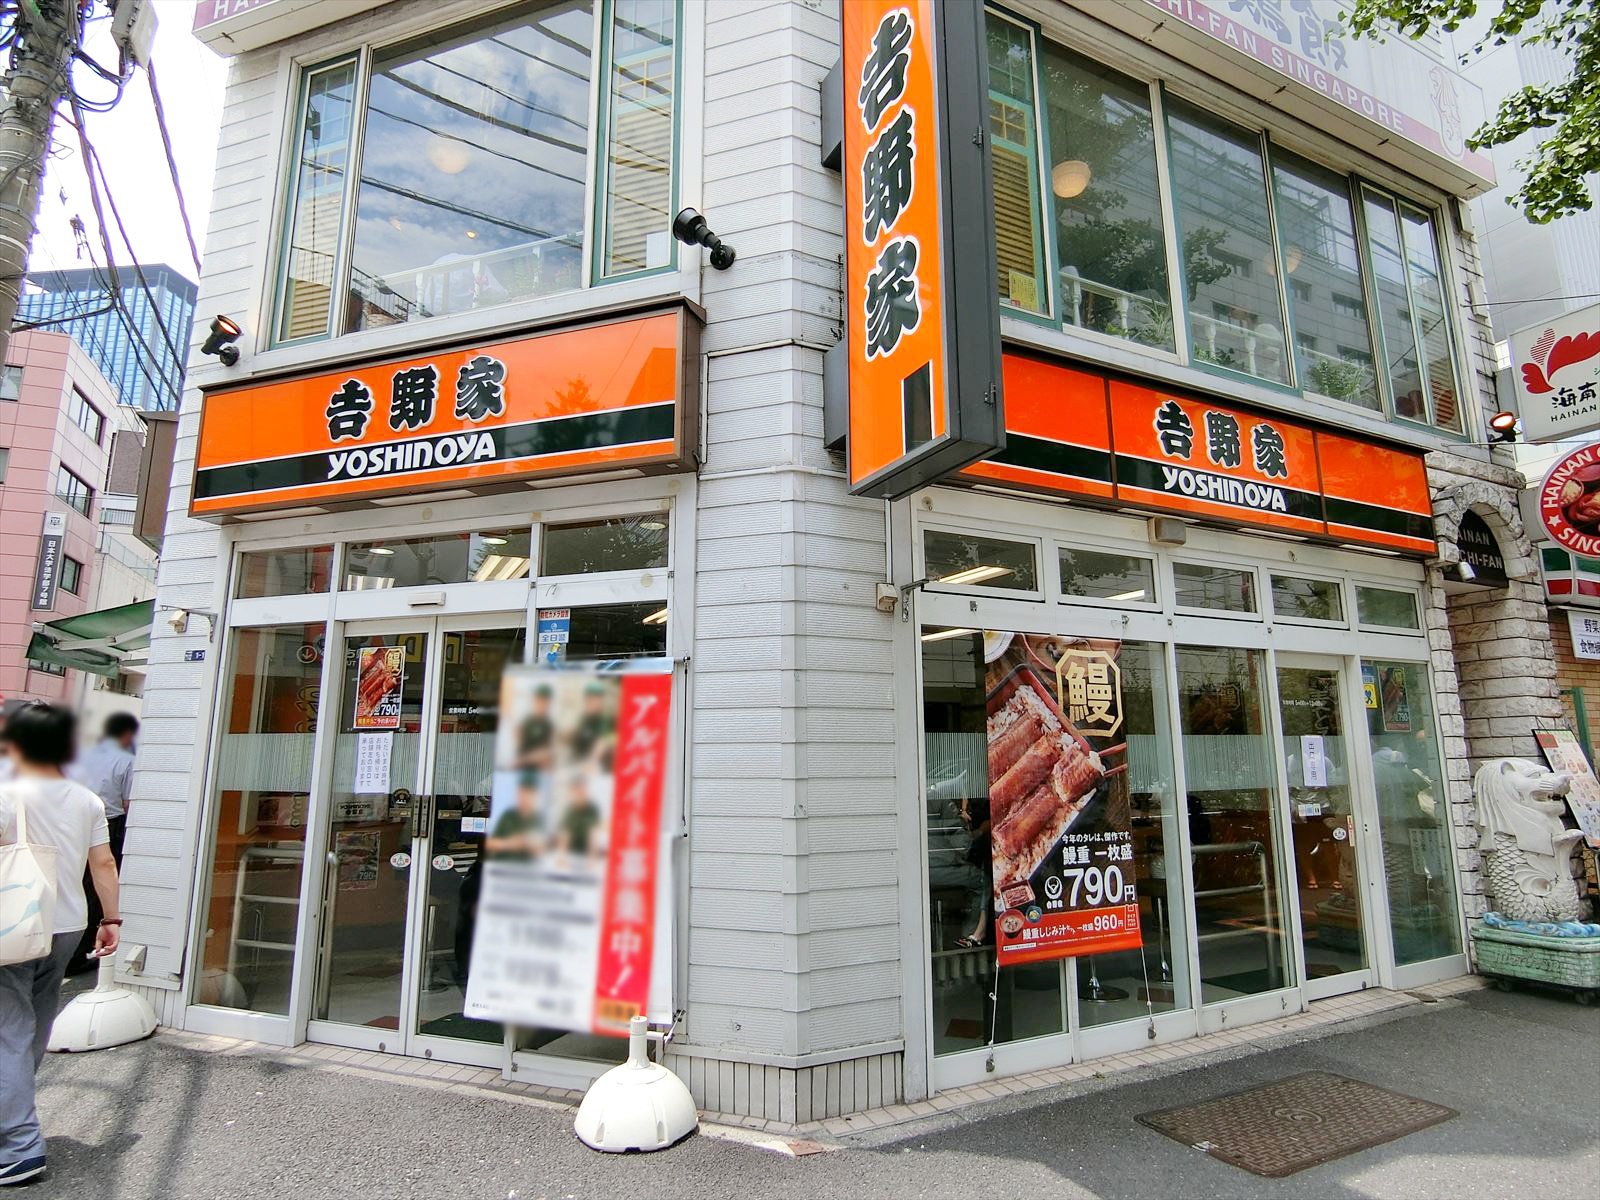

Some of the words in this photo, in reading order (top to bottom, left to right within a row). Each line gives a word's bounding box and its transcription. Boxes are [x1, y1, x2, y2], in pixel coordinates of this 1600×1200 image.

[1271, 46, 1405, 132] SINGAPORE
[858, 8, 920, 361] 吉野家
[325, 356, 507, 443] 吉野家
[1550, 404, 1597, 422] HAINAN
[327, 432, 497, 480] YOSHINOYA
[1153, 400, 1288, 479] 吉野家
[1161, 466, 1287, 512] YOSHINOYA
[1543, 449, 1593, 508] HAINAN
[1457, 528, 1490, 546] AINAN
[1065, 662, 1116, 724] 鰻
[1062, 845, 1090, 865] 鰻重
[1095, 843, 1132, 861] 一枚盛
